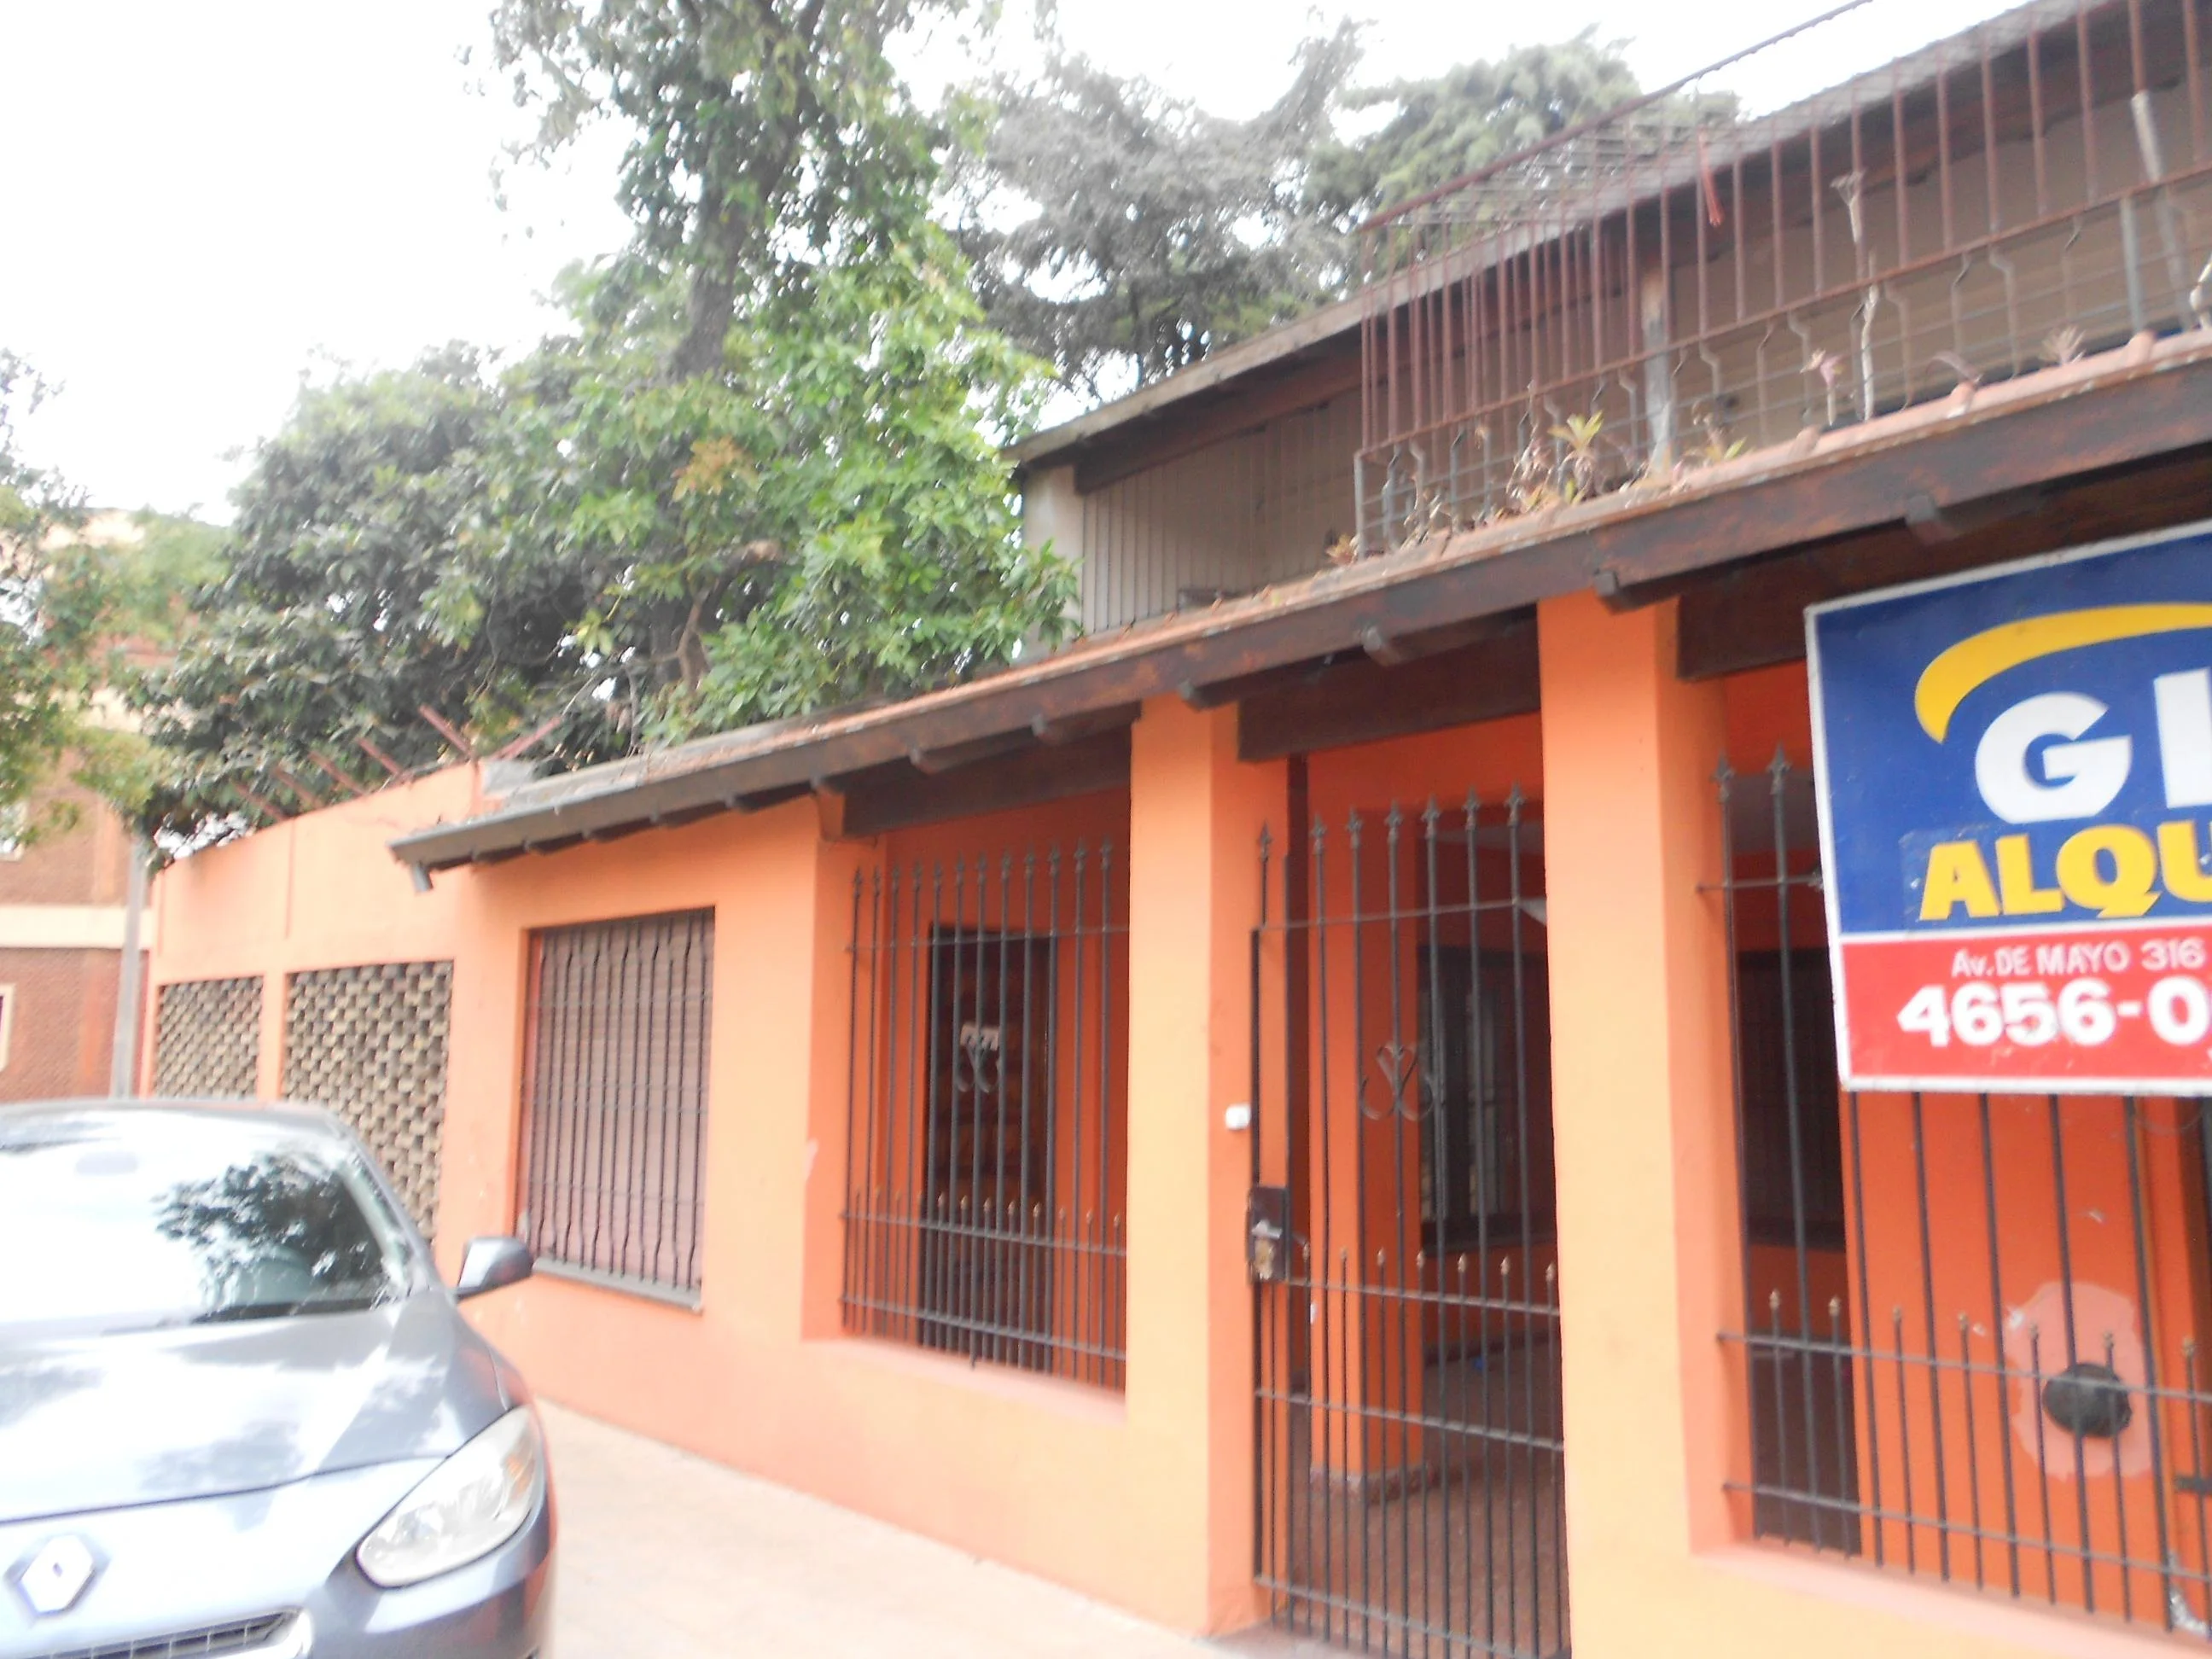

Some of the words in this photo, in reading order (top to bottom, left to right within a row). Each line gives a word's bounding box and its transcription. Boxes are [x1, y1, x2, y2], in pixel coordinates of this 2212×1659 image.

[2036, 940, 2130, 975] MAYO
[2140, 936, 2206, 971] 316
[1896, 975, 2209, 1047] 4656-0
